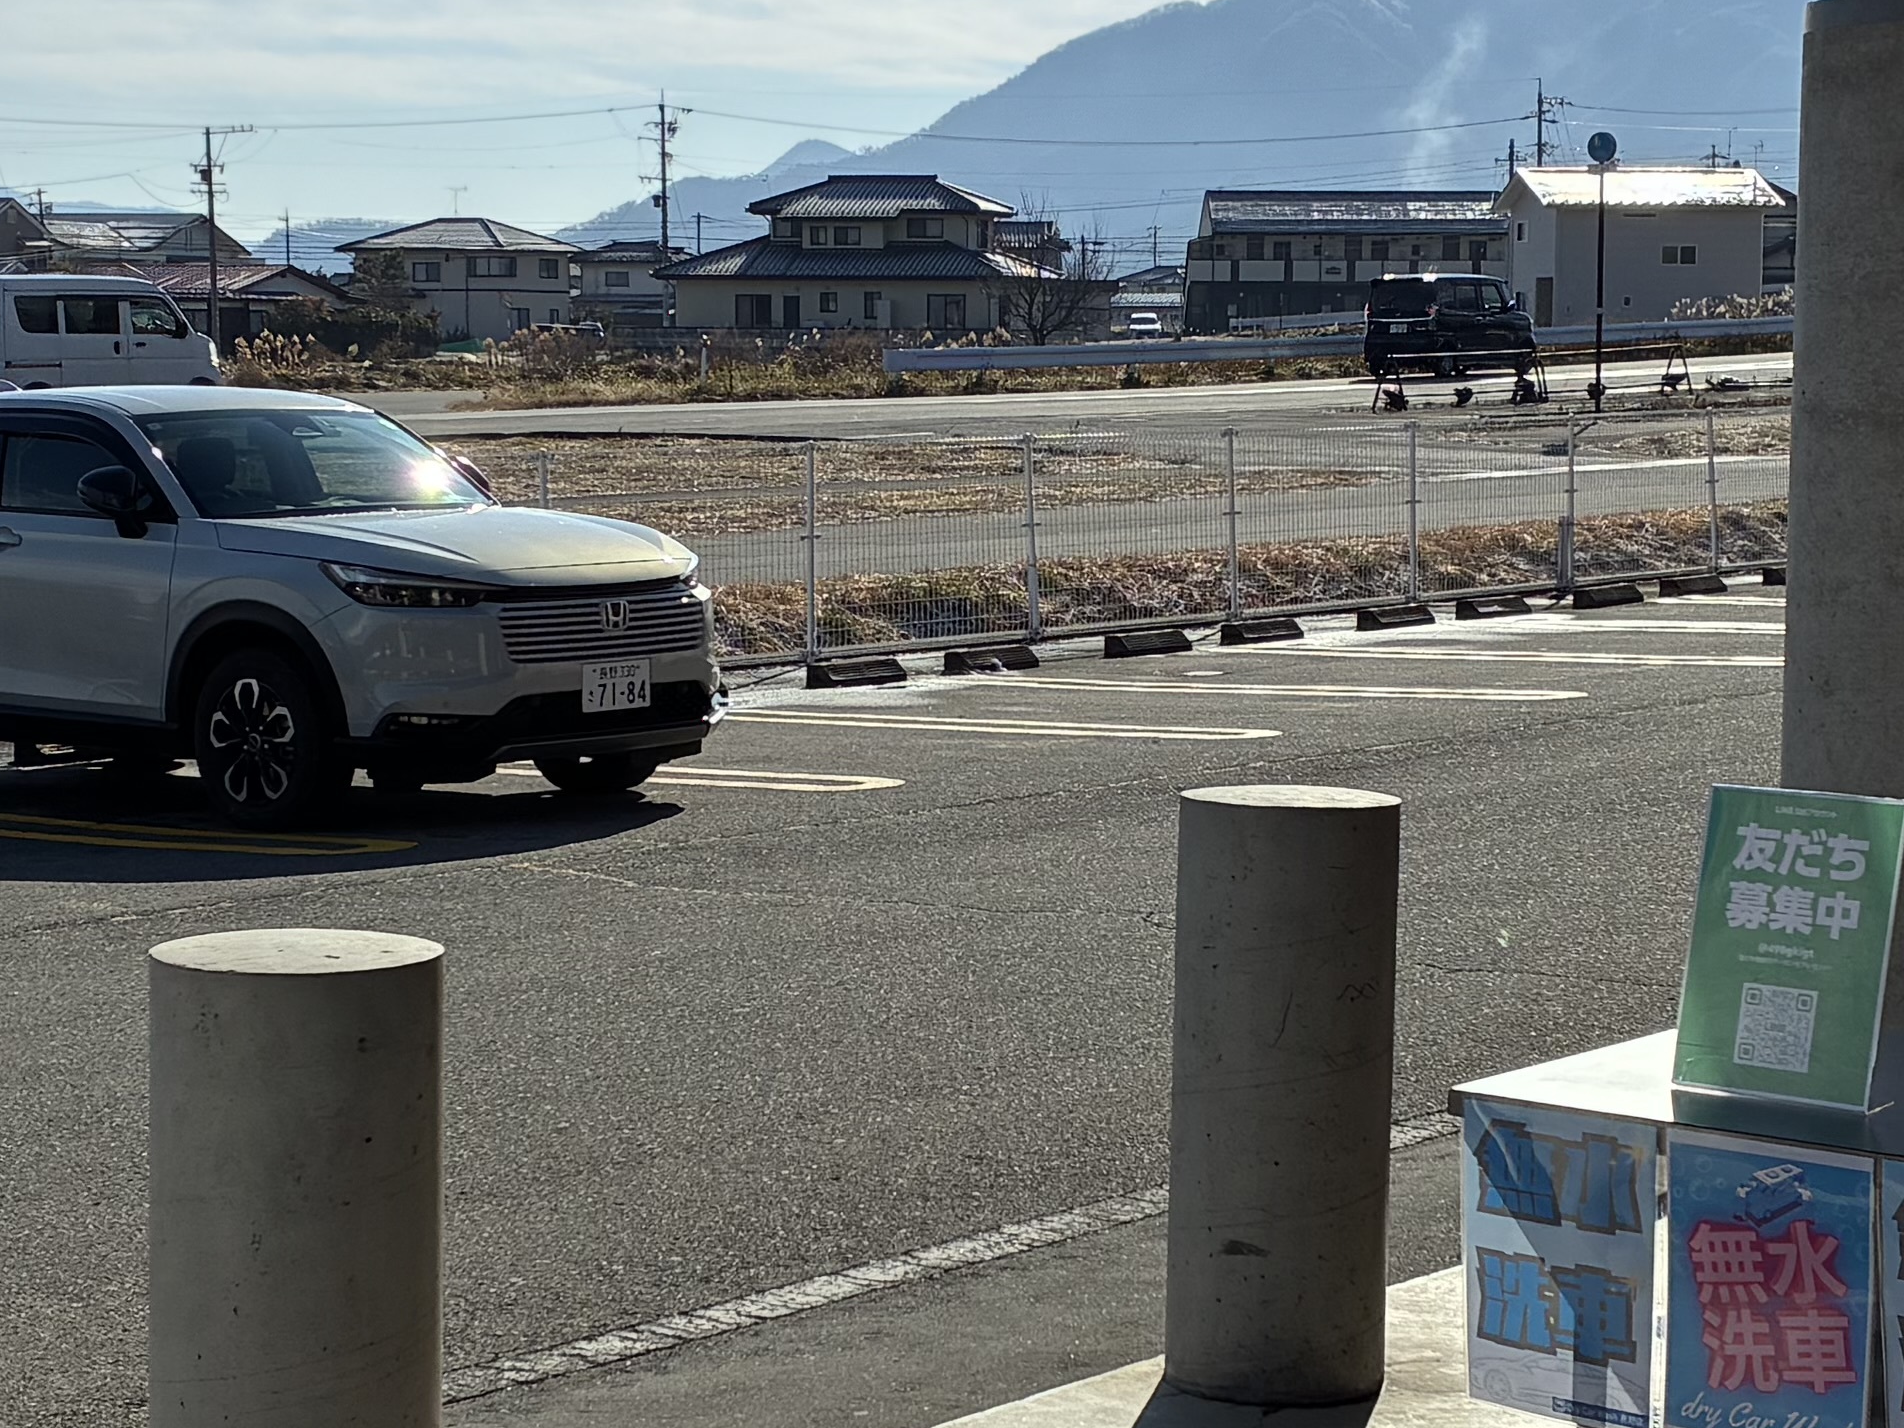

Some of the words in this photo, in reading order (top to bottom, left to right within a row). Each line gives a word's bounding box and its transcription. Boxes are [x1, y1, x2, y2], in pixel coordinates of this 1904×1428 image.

[597, 679, 647, 708] 71-84
[1732, 822, 1870, 882] 友だち
[1725, 880, 1861, 941] 募集中
[1474, 1117, 1643, 1235] 無水
[1688, 1218, 1848, 1305] 無水
[1475, 1245, 1637, 1367] 洗車
[1702, 1308, 1858, 1395] 洗車
